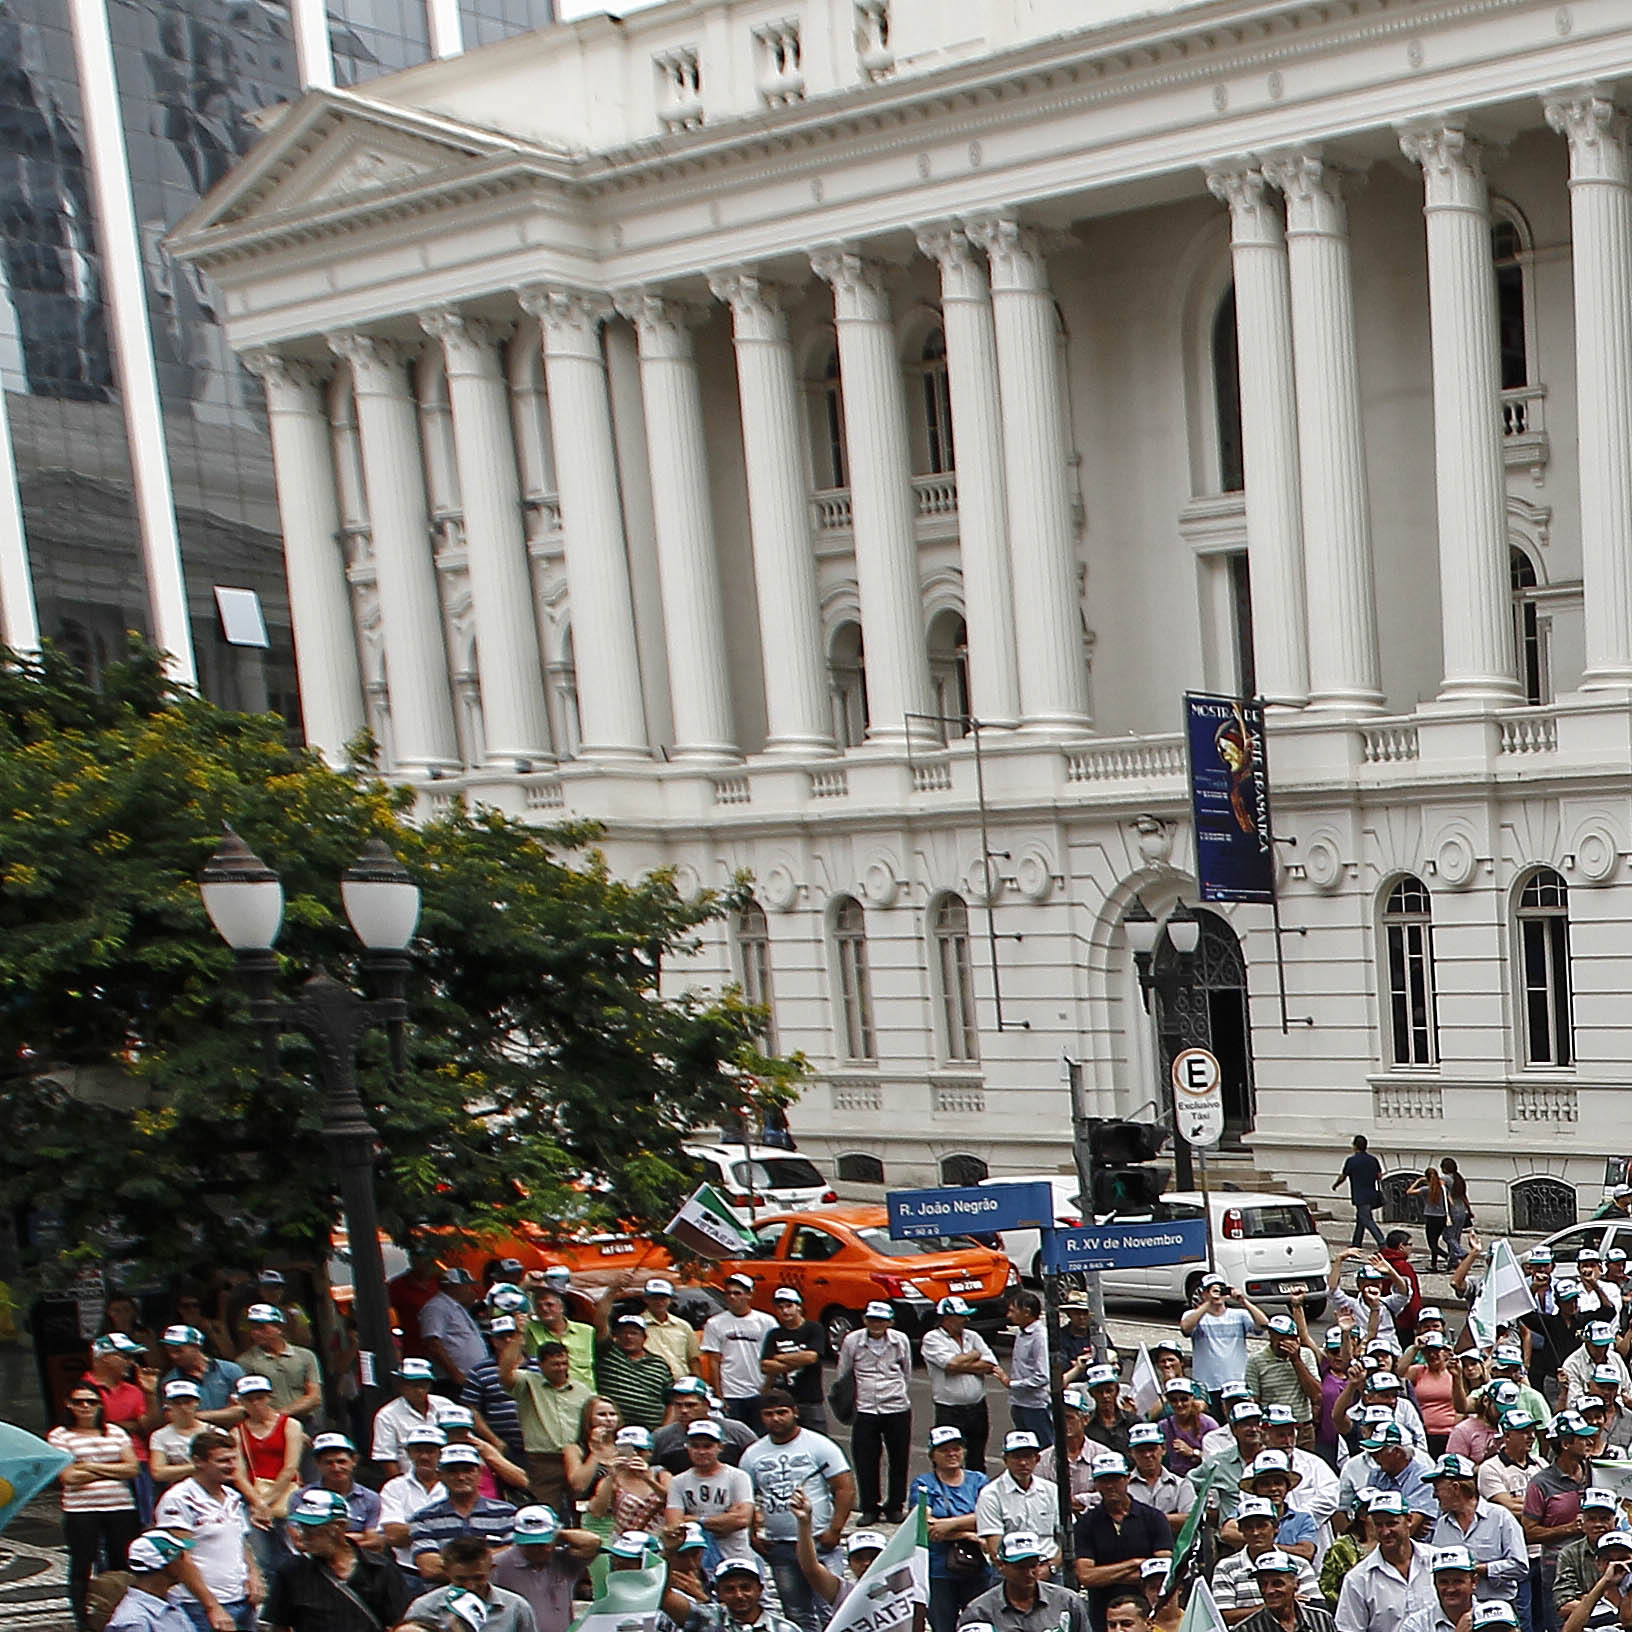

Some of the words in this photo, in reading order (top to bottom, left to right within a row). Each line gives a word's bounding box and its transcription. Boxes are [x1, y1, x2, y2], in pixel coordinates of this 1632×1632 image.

[1186, 1058, 1208, 1088] E
[899, 1203, 915, 1217] R.
[917, 1201, 950, 1216] João
[953, 1197, 998, 1215] Negrão
[1067, 1239, 1080, 1252] R.
[1082, 1239, 1099, 1250] XV
[1103, 1236, 1120, 1249] de
[1122, 1233, 1184, 1249] Novembro
